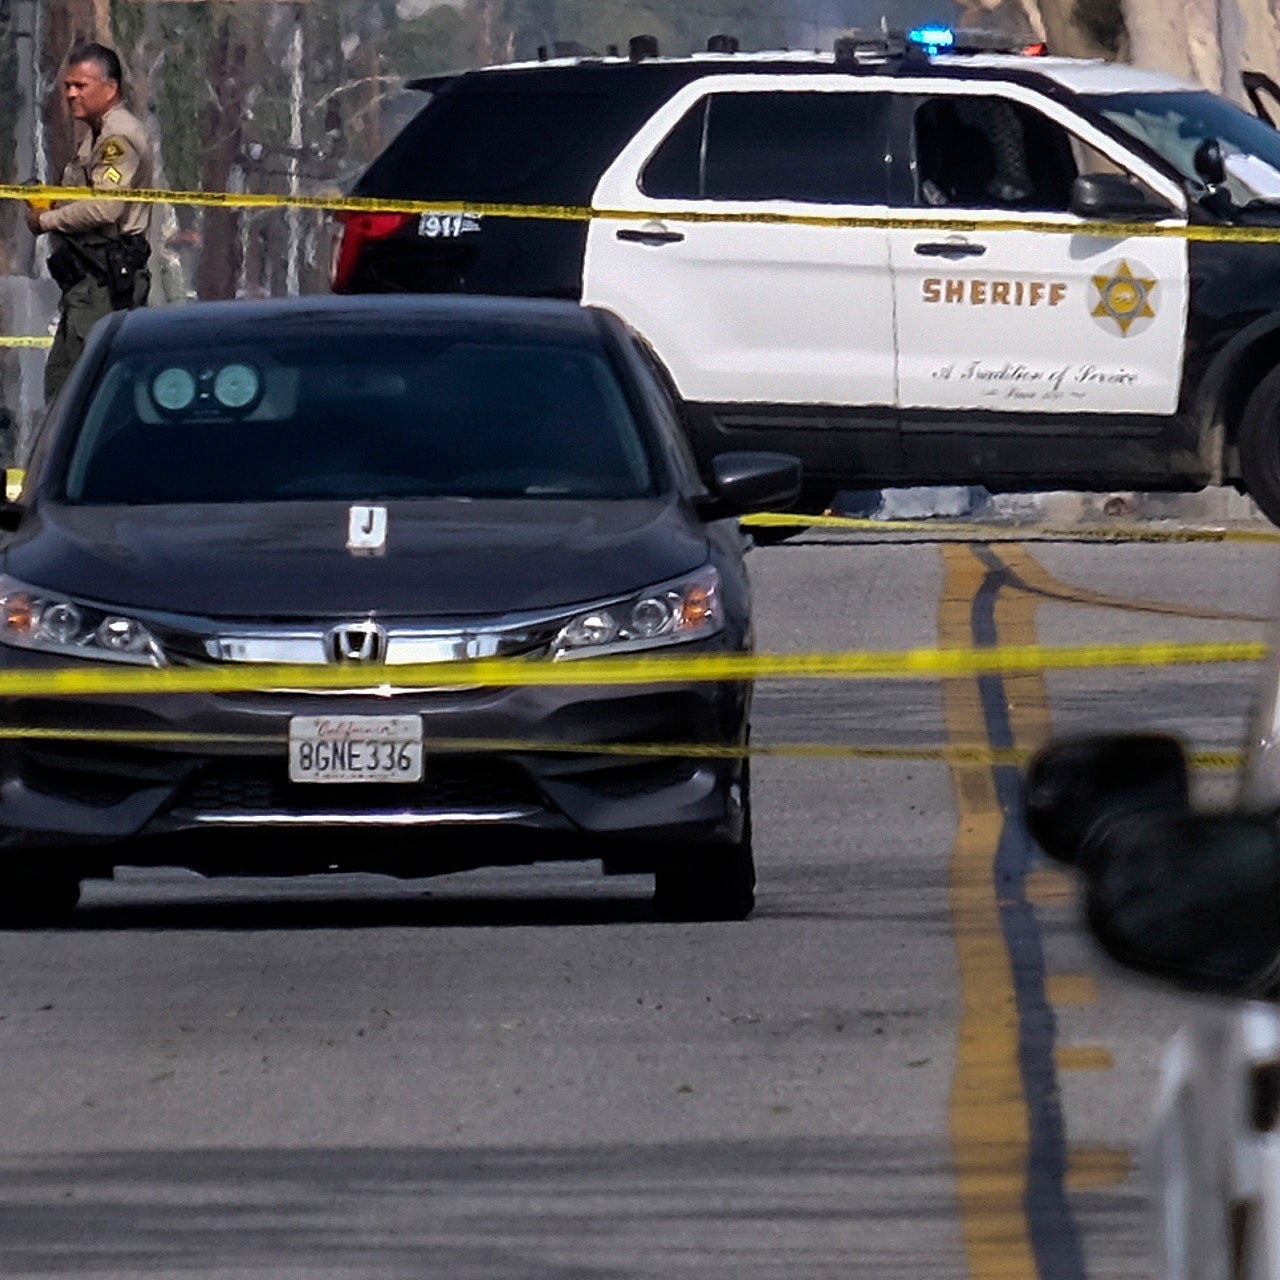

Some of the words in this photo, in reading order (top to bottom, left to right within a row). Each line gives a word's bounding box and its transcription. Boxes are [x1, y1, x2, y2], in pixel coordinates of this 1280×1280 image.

[425, 216, 461, 238] 911
[921, 278, 1068, 307] SHERIFF
[299, 740, 413, 773] 8GNE336
